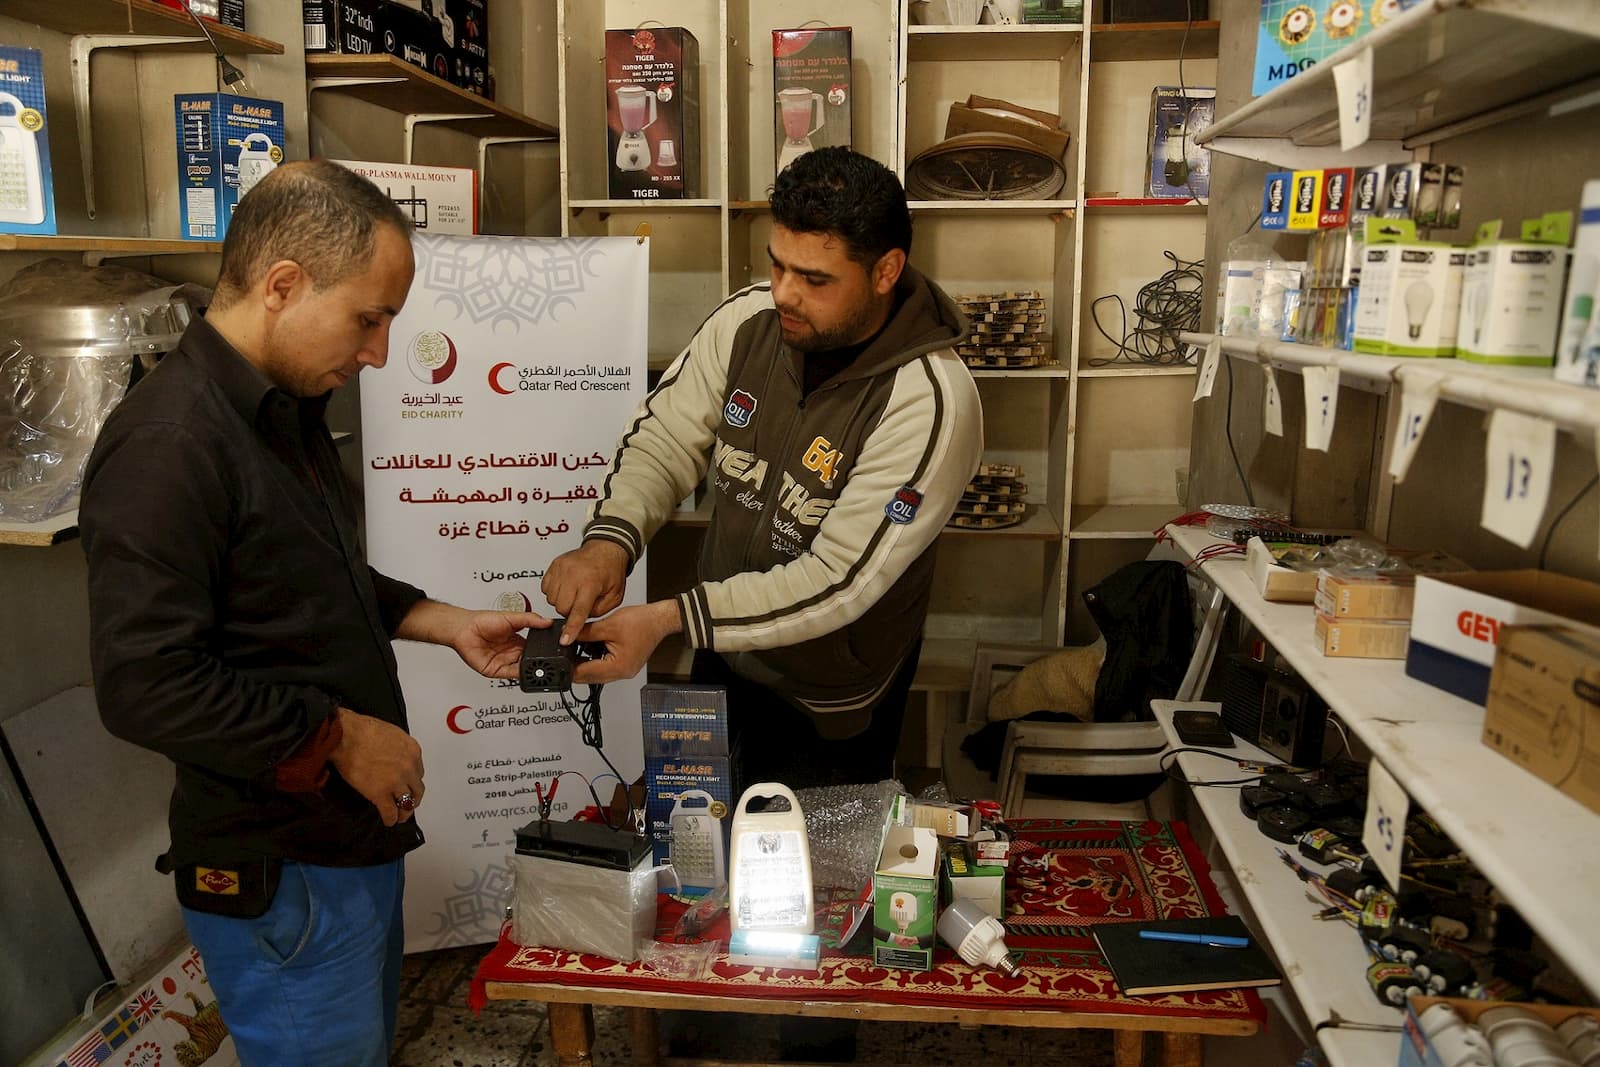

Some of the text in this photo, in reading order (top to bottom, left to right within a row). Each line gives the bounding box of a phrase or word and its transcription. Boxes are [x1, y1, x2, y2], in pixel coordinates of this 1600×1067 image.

[358, 12, 373, 32] inch
[347, 33, 372, 54] LED TV
[6, 73, 31, 83] LIGHT
[181, 101, 211, 111] EL-NASR
[233, 104, 272, 118] EL-NASR
[404, 172, 427, 181] WALL
[428, 174, 456, 182] MOUNT
[632, 189, 659, 198] TIGER
[518, 364, 631, 379] الهلال الأحمر القطري
[519, 380, 631, 391] Qatar Red Crescent
[401, 392, 463, 406] عيد الخيرية
[401, 410, 464, 419] EID CHARITY
[729, 403, 746, 421] OIL
[371, 454, 451, 470] للعائلات
[457, 452, 557, 475] الاقتصادي
[802, 436, 843, 483] 64
[399, 487, 512, 505] المهمشة
[517, 488, 528, 504] و
[778, 471, 835, 526] THE
[893, 501, 911, 517] OIL
[438, 520, 569, 540] في قطاع غزة
[481, 570, 505, 582] من
[475, 704, 514, 718] القطري
[517, 701, 547, 714] الأحمر
[475, 717, 505, 730] Qatar
[508, 716, 530, 727] Red
[661, 730, 712, 742] EL-NASR
[467, 762, 482, 770] غزة
[518, 754, 562, 766] فلسطين
[663, 764, 713, 775] EL-NASR
[467, 776, 491, 785] Gaza
[485, 791, 507, 799] 2018
[464, 801, 568, 820] www.qrcs.o.qa
